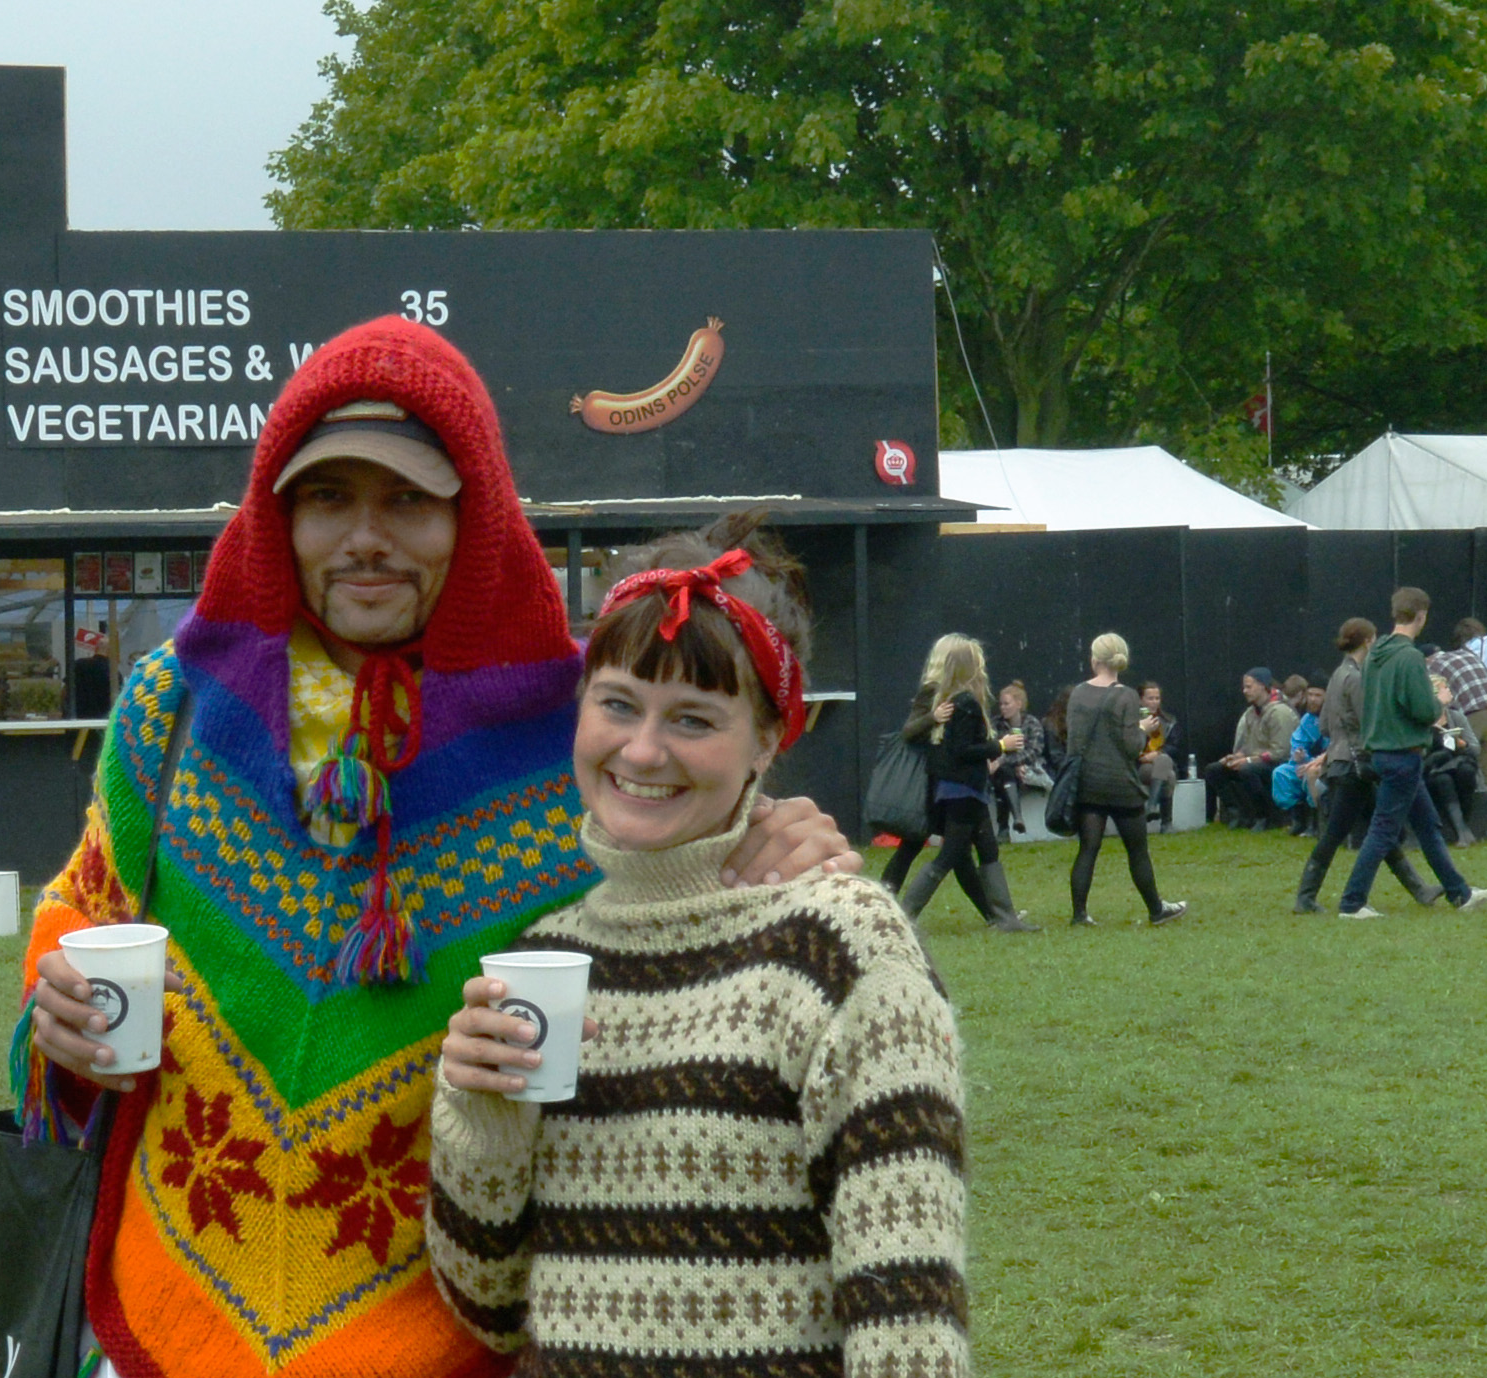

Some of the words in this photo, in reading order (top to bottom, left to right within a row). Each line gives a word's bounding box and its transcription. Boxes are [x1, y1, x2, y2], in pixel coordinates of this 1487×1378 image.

[3, 289, 251, 327] SMOOTHIES
[400, 290, 449, 326] 35
[5, 345, 233, 384] SAUSAGES
[245, 344, 274, 381] &
[609, 398, 667, 426] ODINS
[666, 352, 715, 406] POLSE
[7, 403, 274, 442] VEGETARIAN
